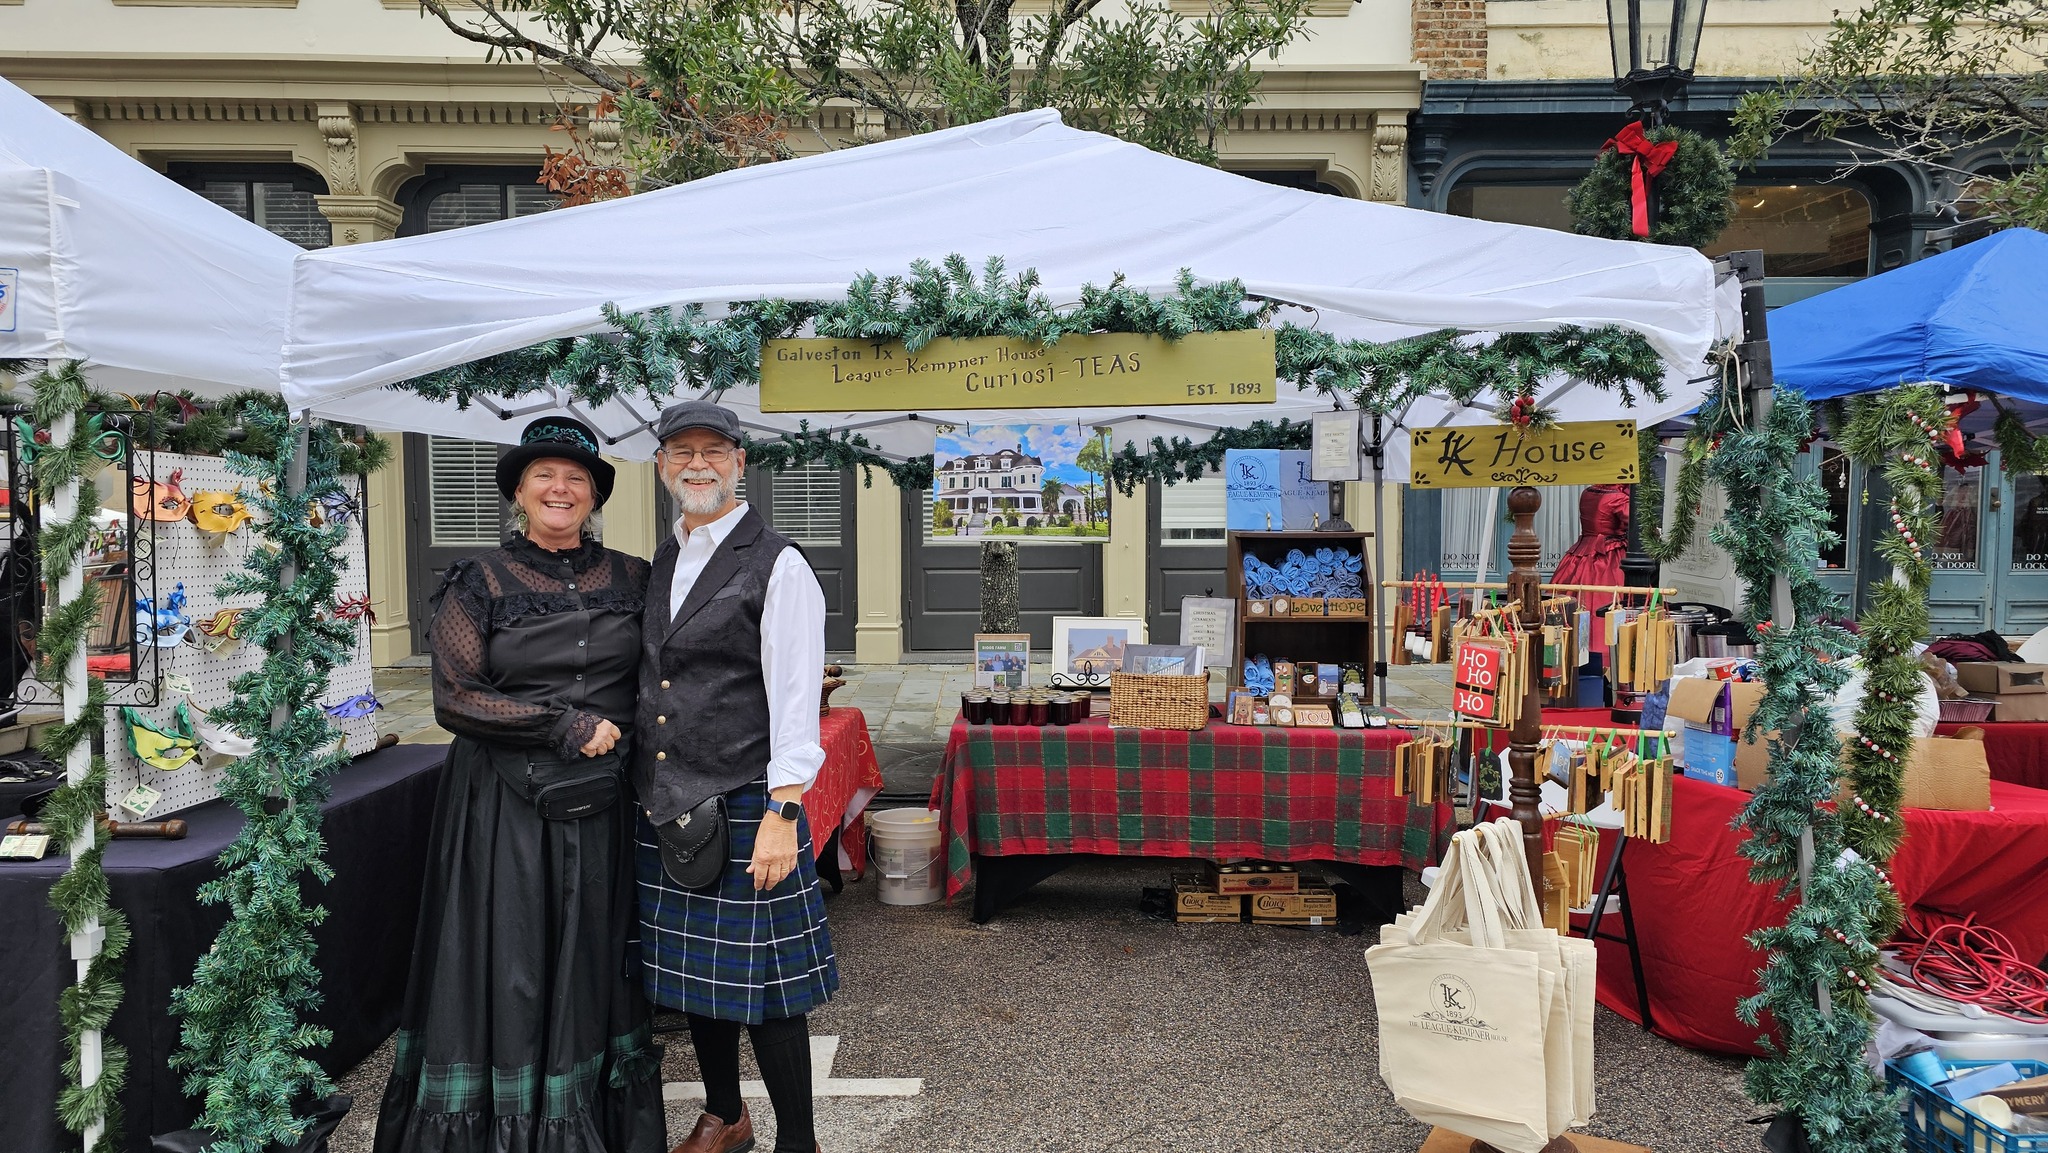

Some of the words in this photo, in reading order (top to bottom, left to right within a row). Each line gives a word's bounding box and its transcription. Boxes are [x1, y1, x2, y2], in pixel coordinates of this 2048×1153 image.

[777, 346, 861, 362] Galveston
[870, 343, 893, 361] Tx
[832, 354, 989, 384] League-Kempner
[996, 346, 1045, 363] House
[966, 352, 1141, 392] Curiosi-TEAS
[1187, 384, 1218, 397] EST.
[1230, 383, 1262, 395] 1893
[1489, 431, 1606, 467] House
[1947, 561, 1976, 569] DOOR
[2026, 553, 2041, 561] DO
[2012, 562, 2046, 570] BLOCK
[1461, 648, 1487, 668] HO
[1466, 667, 1492, 685] HO
[1459, 692, 1484, 711] HO
[1257, 895, 1286, 912] CHOICE
[1446, 1010, 1462, 1018] 1893
[2003, 1095, 2046, 1107] YMERY
